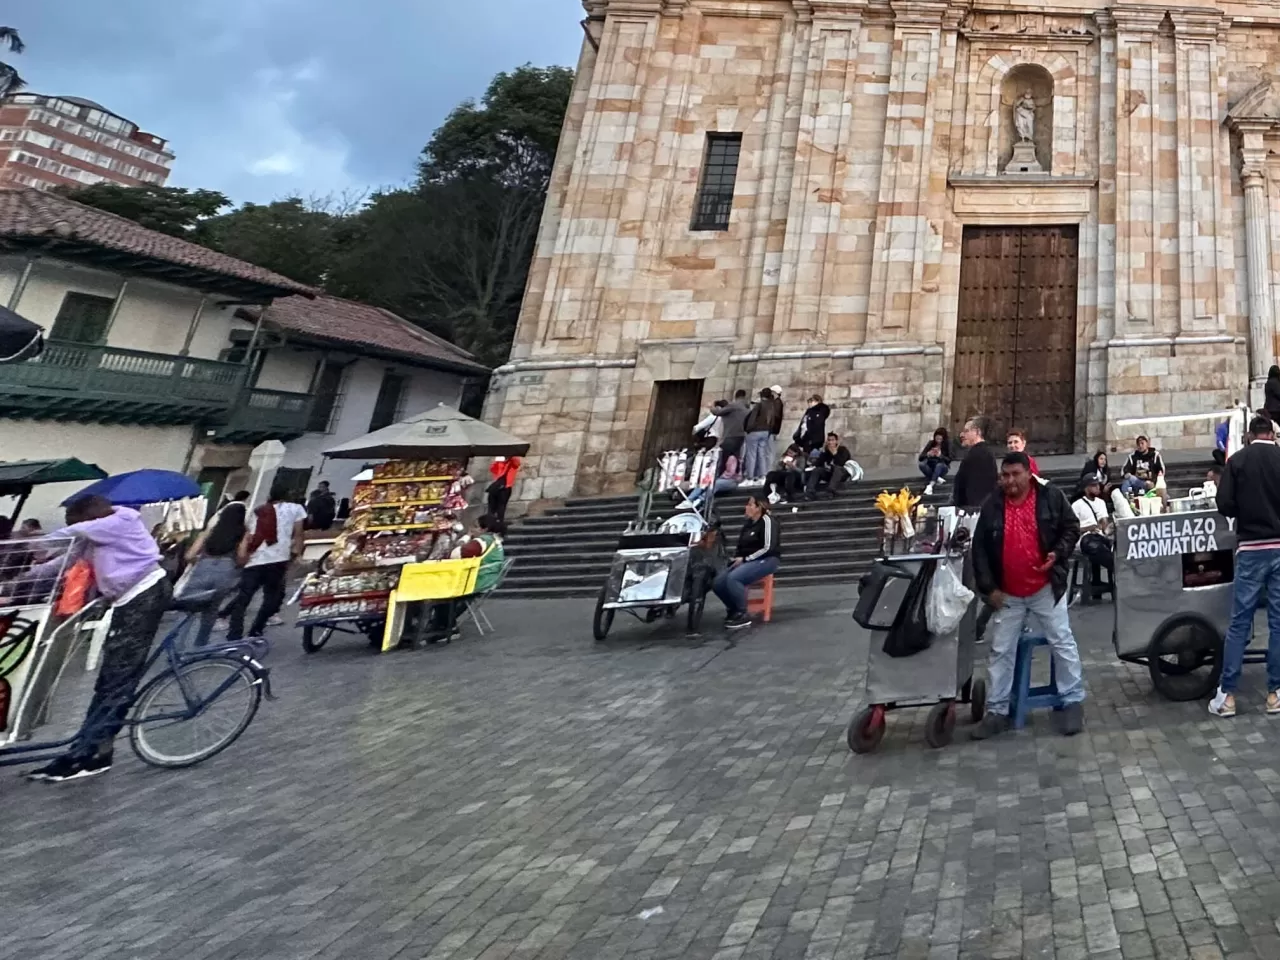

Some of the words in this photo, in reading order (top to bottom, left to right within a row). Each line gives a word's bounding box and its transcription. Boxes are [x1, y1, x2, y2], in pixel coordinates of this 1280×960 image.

[1127, 517, 1216, 542] CANELAZO
[1225, 516, 1235, 531] Y
[1126, 534, 1218, 560] AROMATICA
